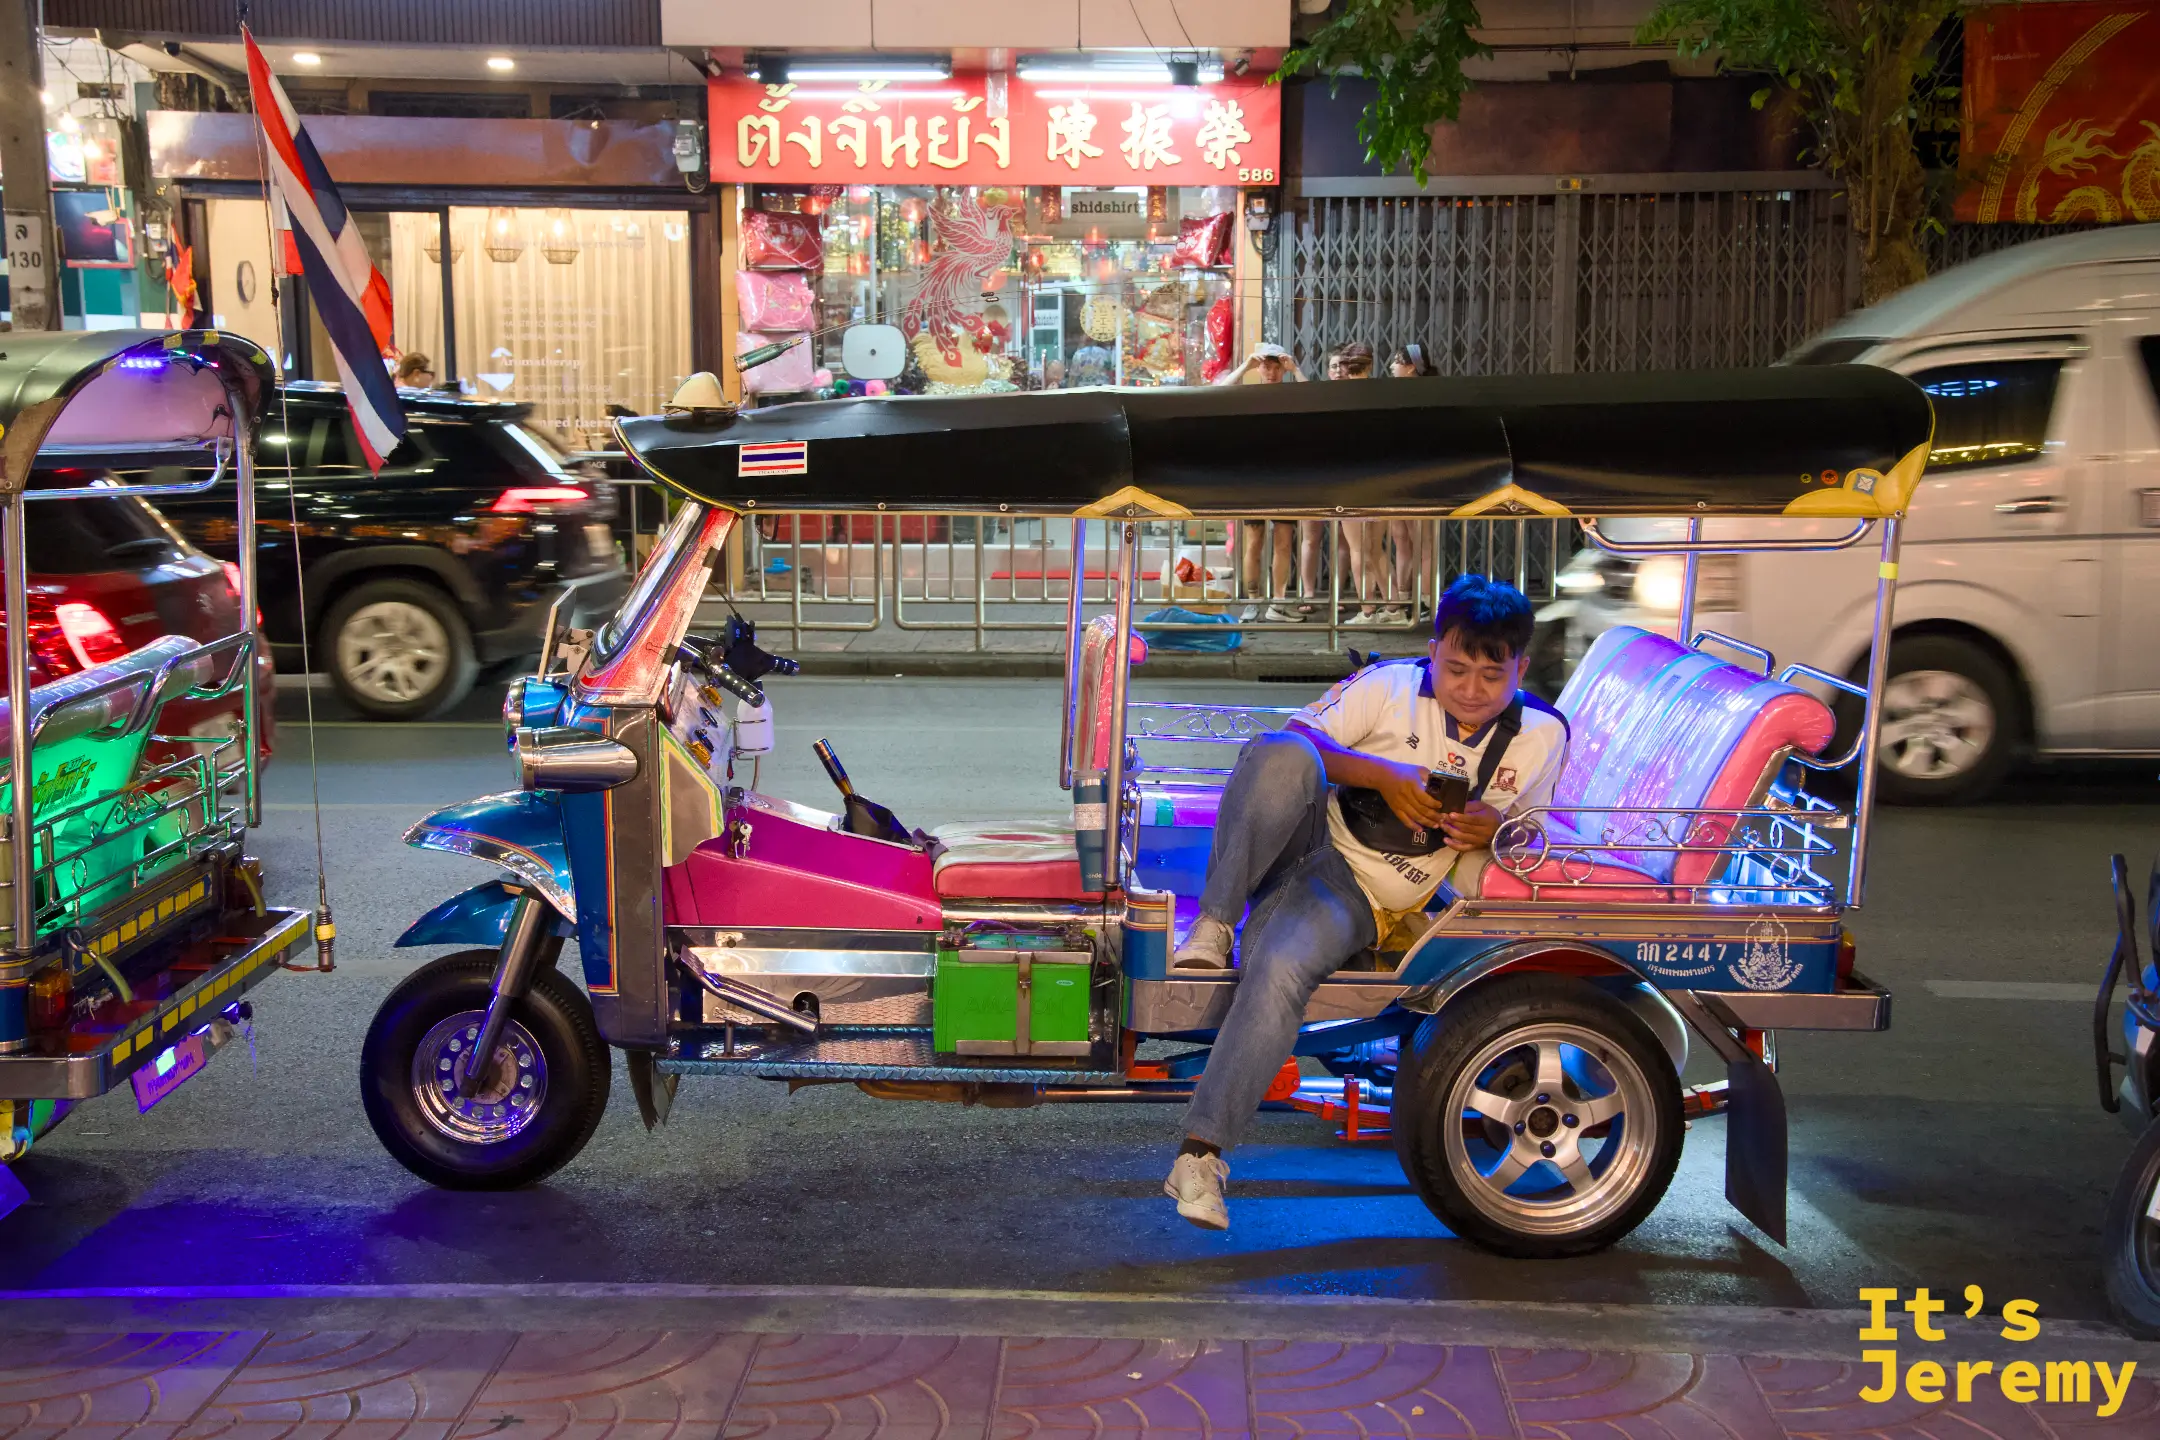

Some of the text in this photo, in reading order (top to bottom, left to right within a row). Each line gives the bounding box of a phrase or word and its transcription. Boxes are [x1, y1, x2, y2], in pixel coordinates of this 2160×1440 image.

[1046, 98, 1252, 171] 陳振榮
[1238, 168, 1274, 183] 586
[1071, 200, 1140, 214] shidshirt
[9, 251, 41, 269] 130
[1450, 765, 1469, 778] STEEL
[1665, 942, 1728, 963] 2447
[1647, 963, 1716, 978] กรุงเทพมหานคร
[964, 995, 1066, 1016] AMAON
